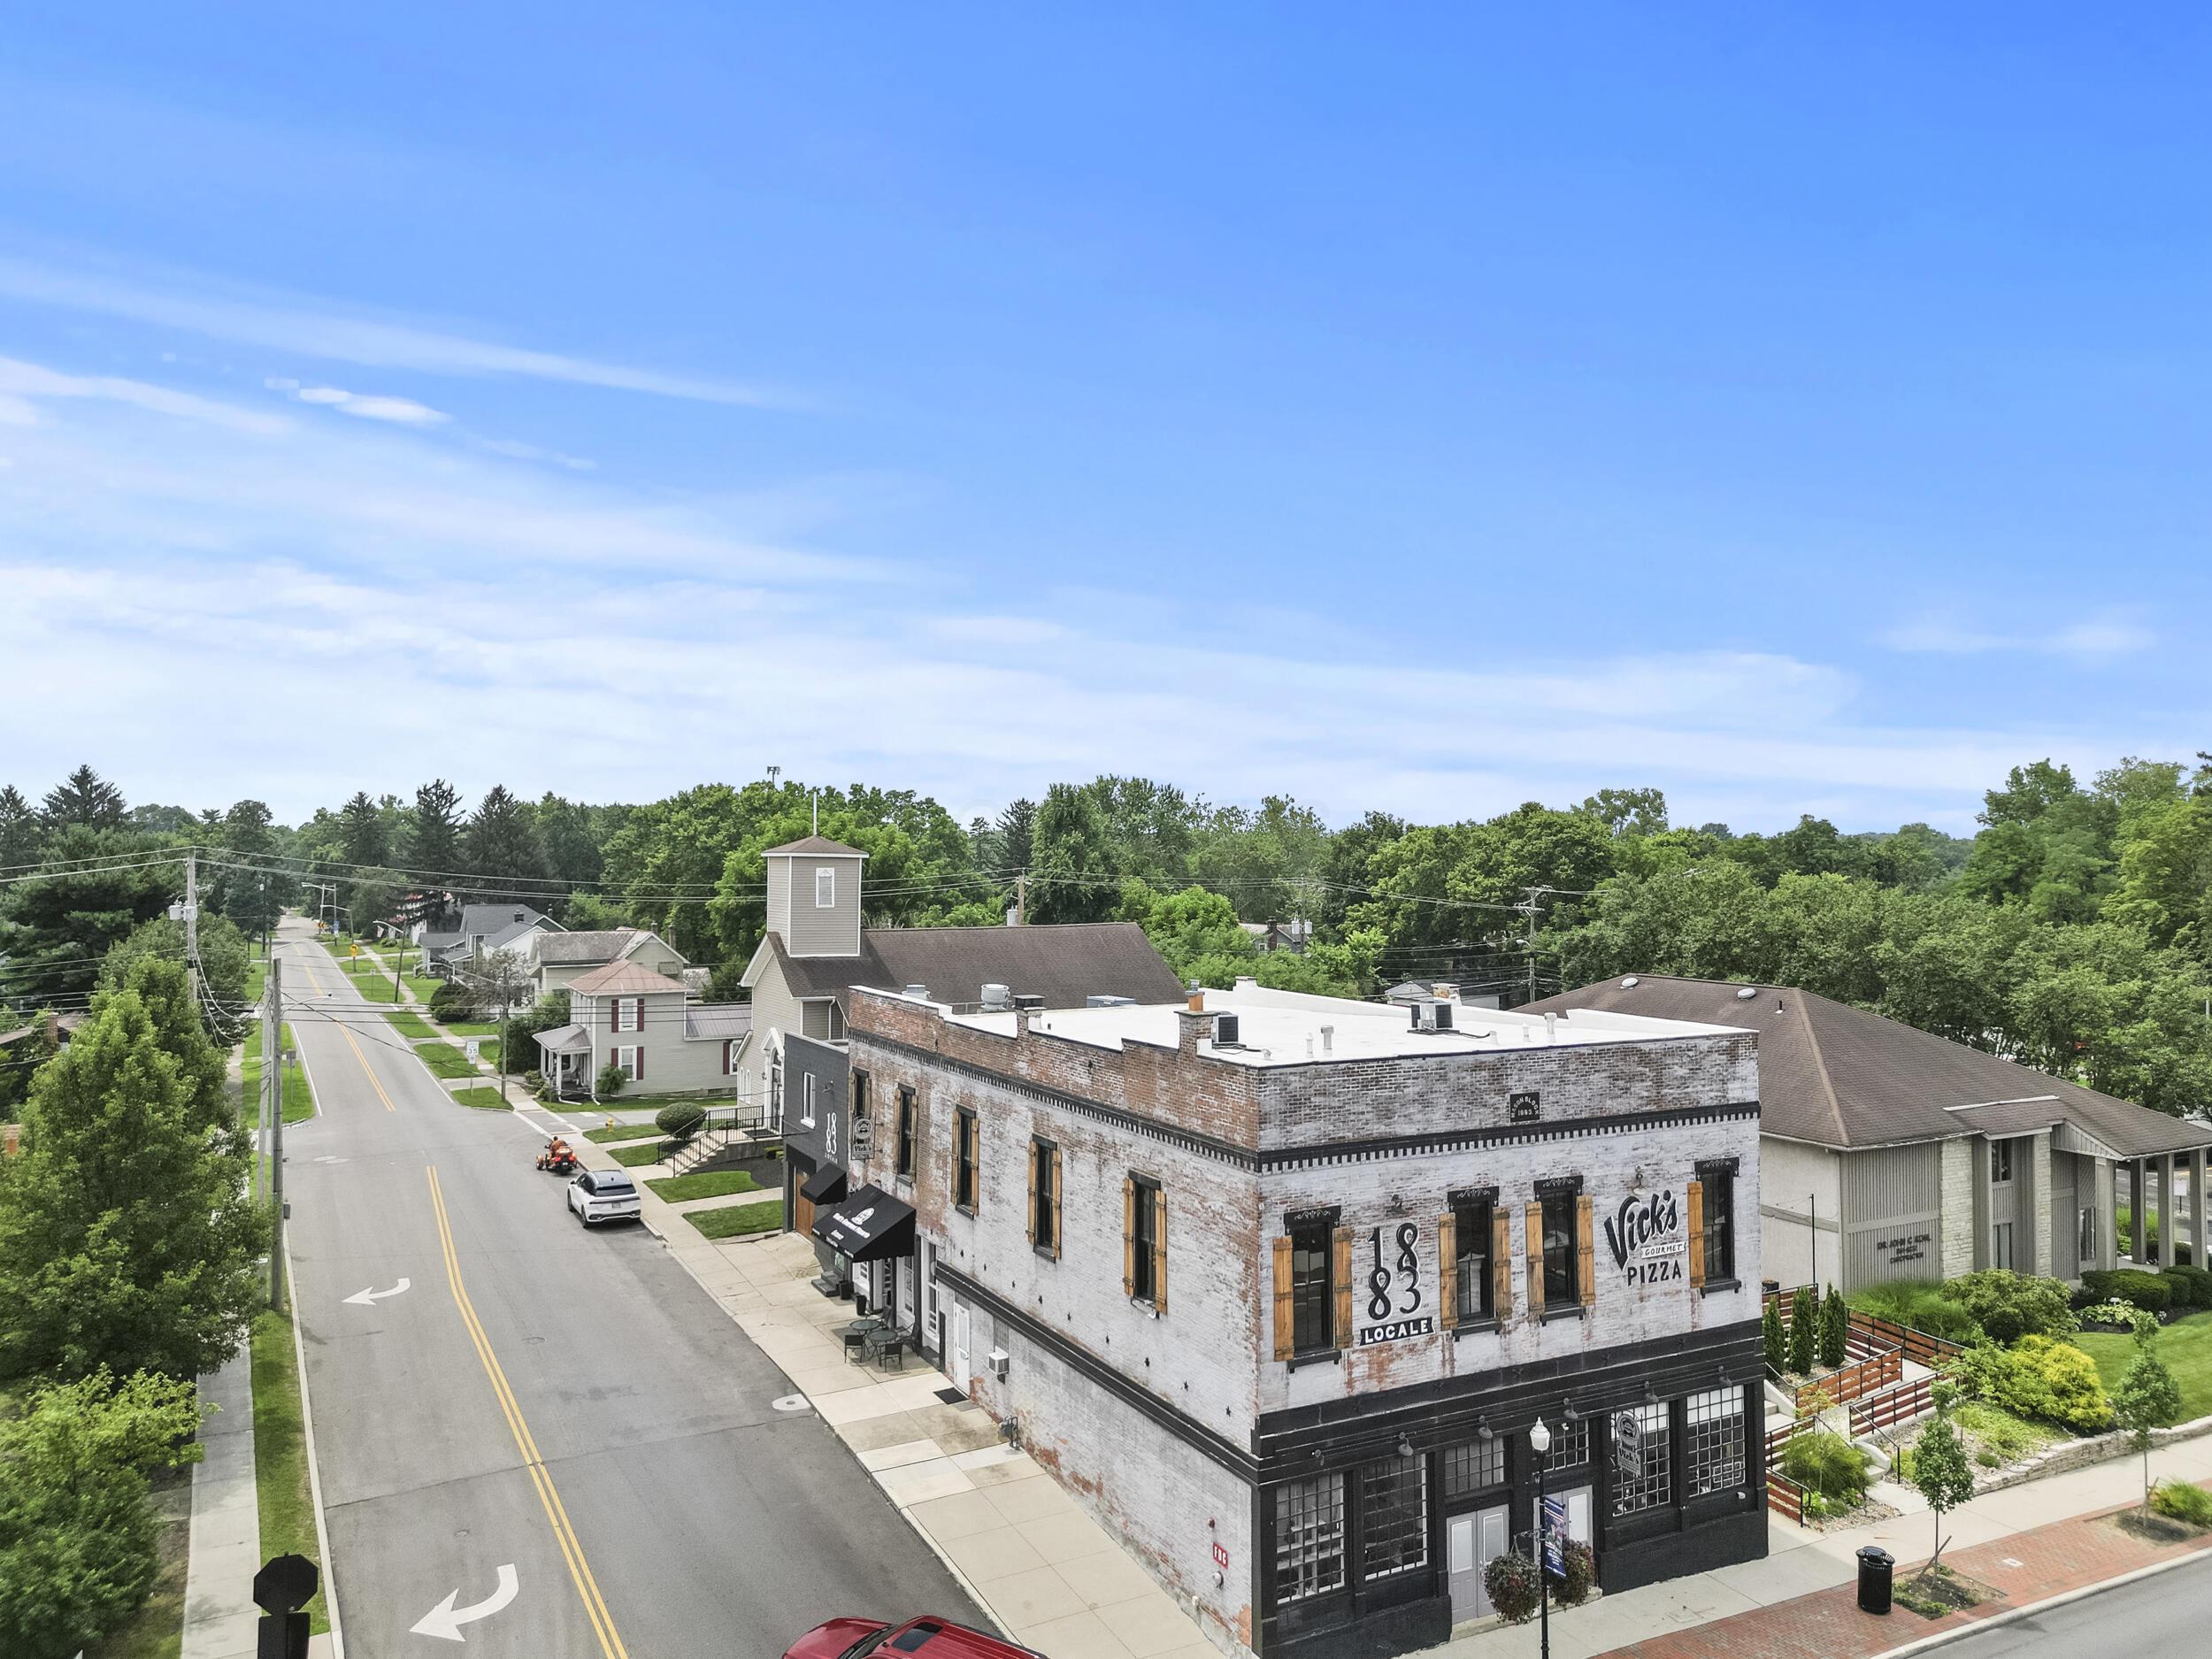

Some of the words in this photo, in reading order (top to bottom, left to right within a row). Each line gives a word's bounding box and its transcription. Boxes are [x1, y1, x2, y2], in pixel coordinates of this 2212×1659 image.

[1604, 1190, 1678, 1271] Vick's
[1645, 1245, 1681, 1256] GOURMET
[1628, 1259, 1682, 1287] PIZZA
[1364, 1319, 1428, 1344] LOCALE
